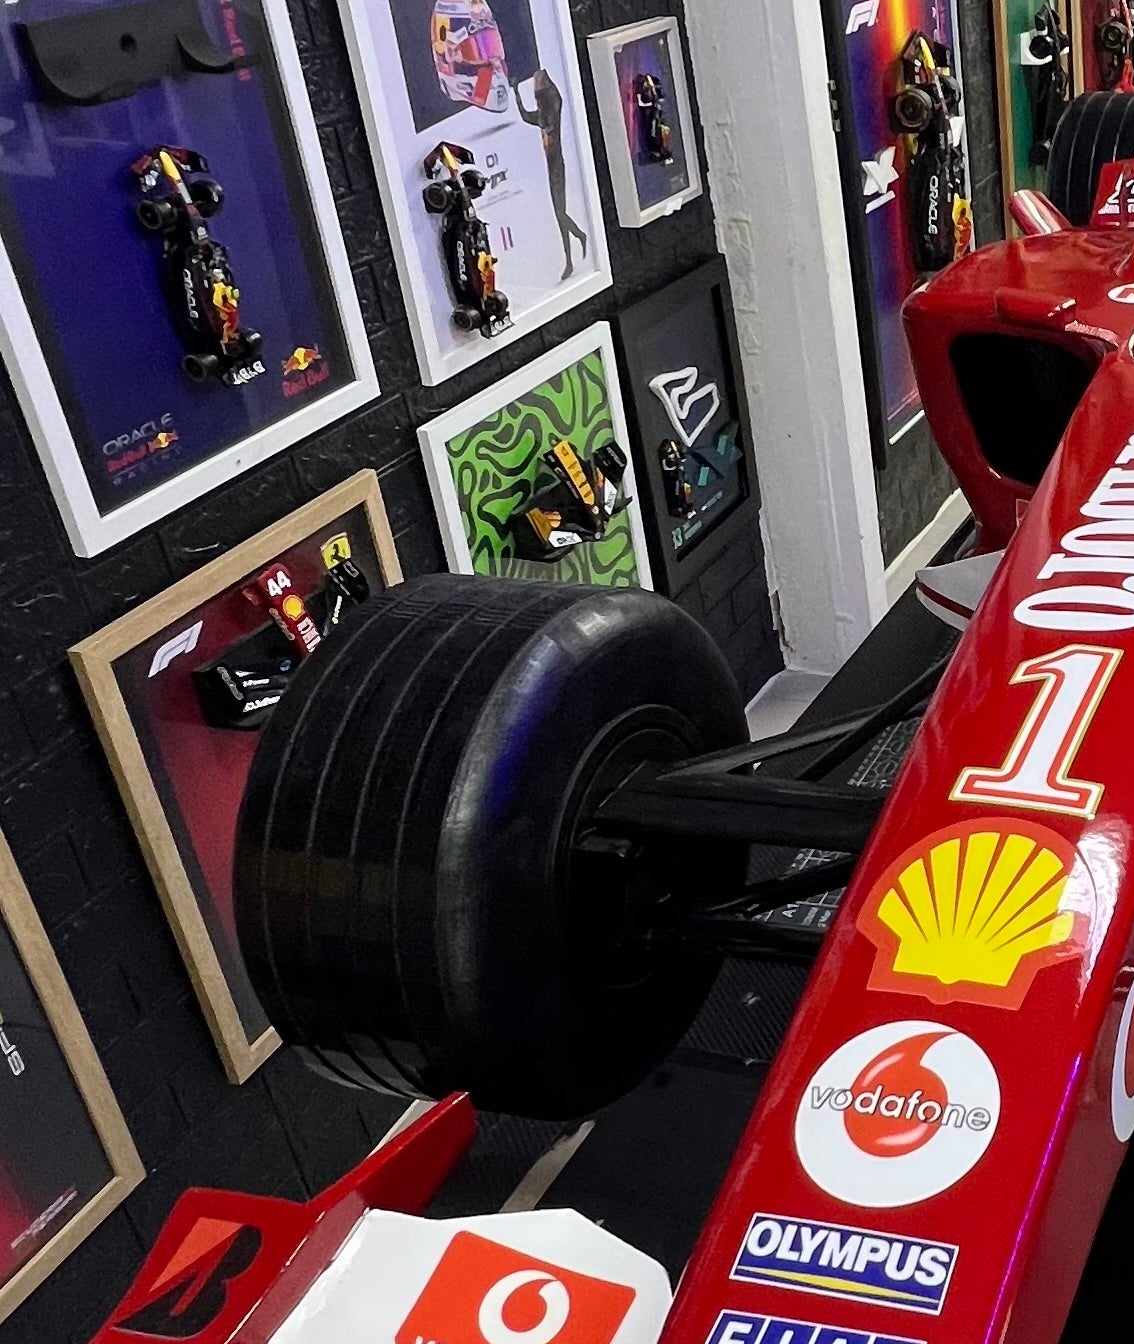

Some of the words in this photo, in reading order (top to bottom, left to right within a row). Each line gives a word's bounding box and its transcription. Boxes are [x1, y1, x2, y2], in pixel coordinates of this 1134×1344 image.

[929, 174, 938, 236] ORACLE
[267, 570, 292, 597] 44
[947, 644, 1125, 820] 1
[811, 1084, 992, 1132] vodafone
[746, 1219, 950, 1288] OLYMPUS
